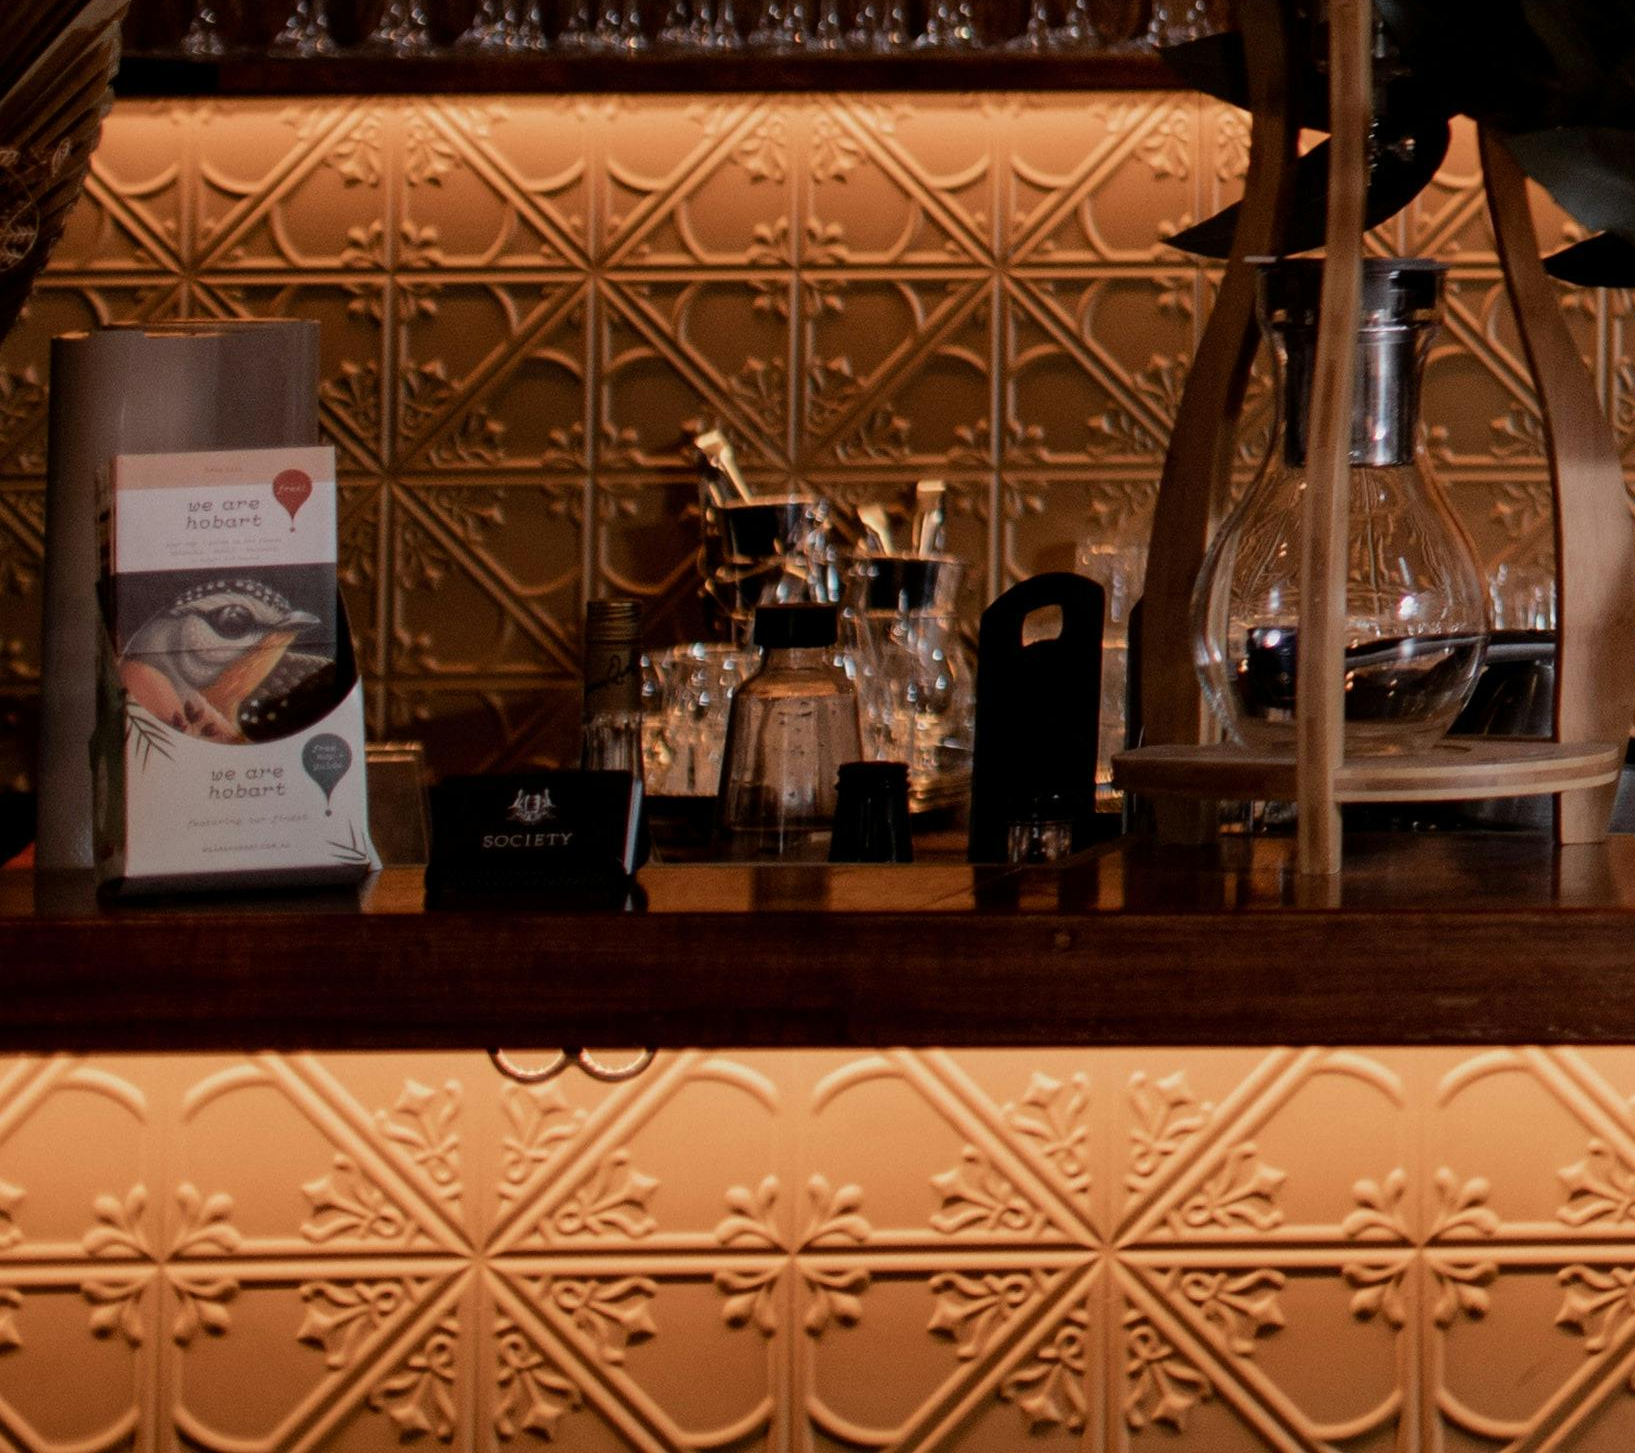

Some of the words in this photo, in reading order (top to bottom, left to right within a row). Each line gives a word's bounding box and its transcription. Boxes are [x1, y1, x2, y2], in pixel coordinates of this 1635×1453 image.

[187, 501, 212, 512] we
[222, 500, 260, 510] are
[186, 514, 262, 529] hobart
[211, 769, 236, 780] we
[246, 767, 283, 778] are
[209, 782, 286, 799] hobart
[482, 831, 573, 848] SOCIETY
